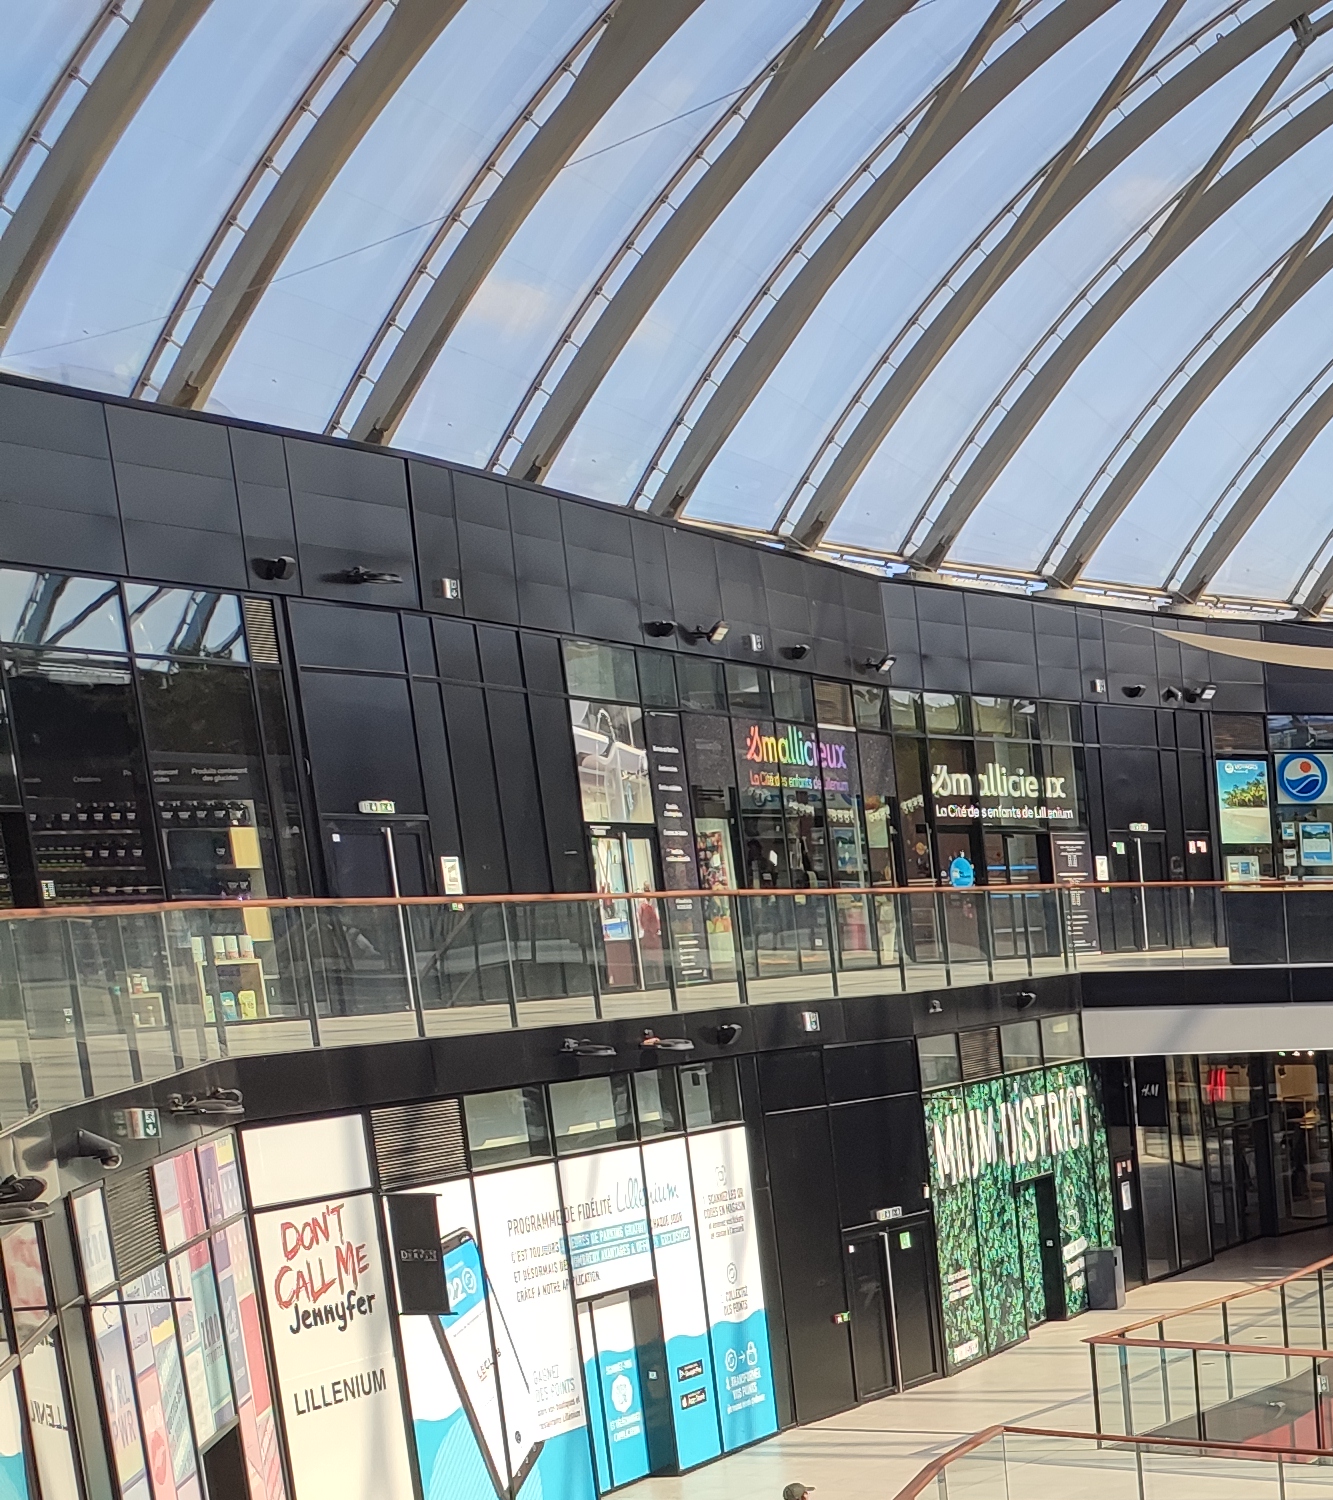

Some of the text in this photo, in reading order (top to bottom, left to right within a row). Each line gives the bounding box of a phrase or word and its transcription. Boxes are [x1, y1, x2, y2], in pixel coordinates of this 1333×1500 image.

[936, 804, 947, 817] La
[948, 804, 967, 819] Cité
[987, 805, 1021, 819] enfants
[1022, 805, 1033, 819] de
[280, 1203, 345, 1262] DON'T
[507, 1209, 563, 1237] PROGRAMME
[564, 1205, 575, 1223] DE
[578, 1195, 612, 1221] FIDÉLITÉ
[273, 1241, 370, 1310] CALL ME
[562, 1270, 601, 1290] APLICATION
[290, 1290, 375, 1334] Jennyfer
[293, 1367, 387, 1416] LILLENIUM
